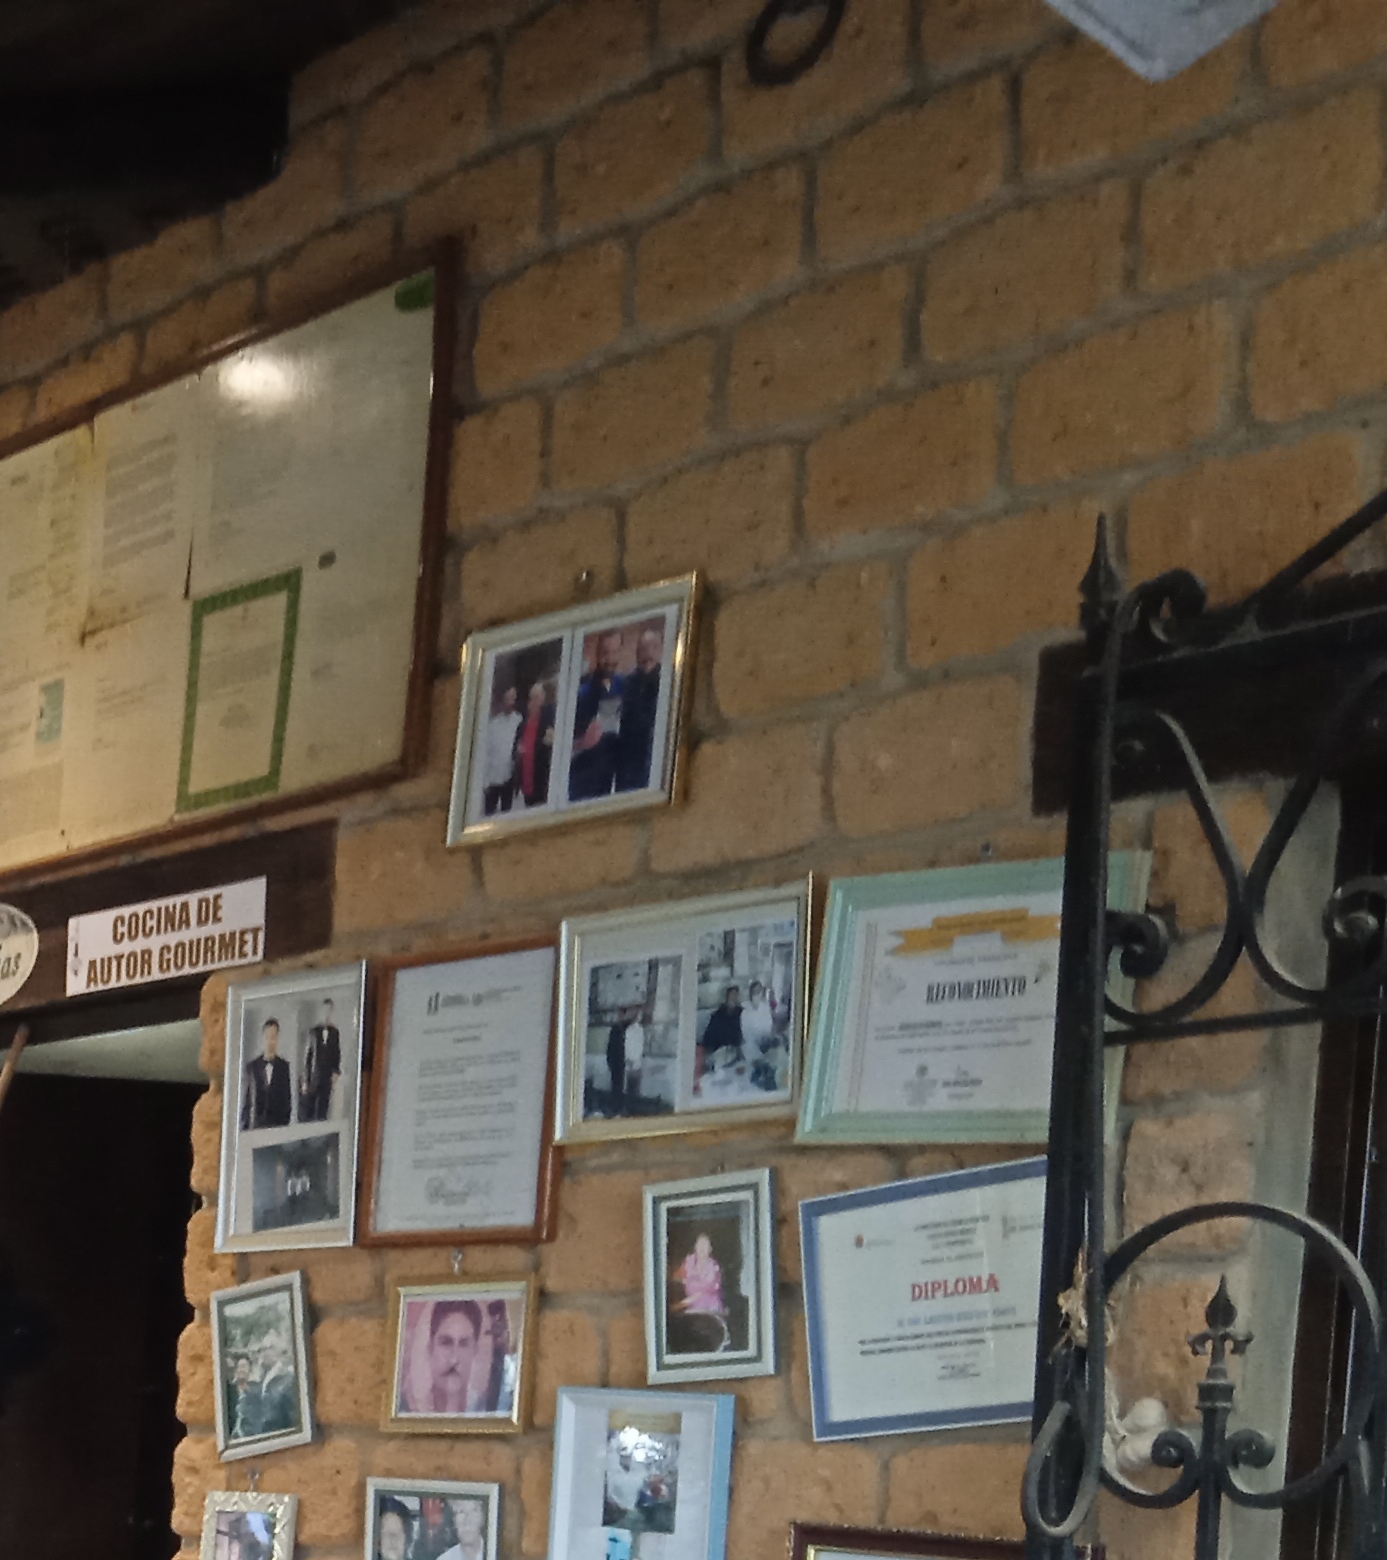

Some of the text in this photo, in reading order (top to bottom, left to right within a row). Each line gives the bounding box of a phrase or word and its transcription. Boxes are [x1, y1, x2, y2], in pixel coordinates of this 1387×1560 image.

[112, 892, 223, 945] COCINA DE
[86, 948, 153, 990] AUTOR
[158, 926, 263, 975] GOURMET
[926, 975, 1026, 1005] RECONOCIMIENTO
[911, 1272, 1000, 1302] DIPLOMA
